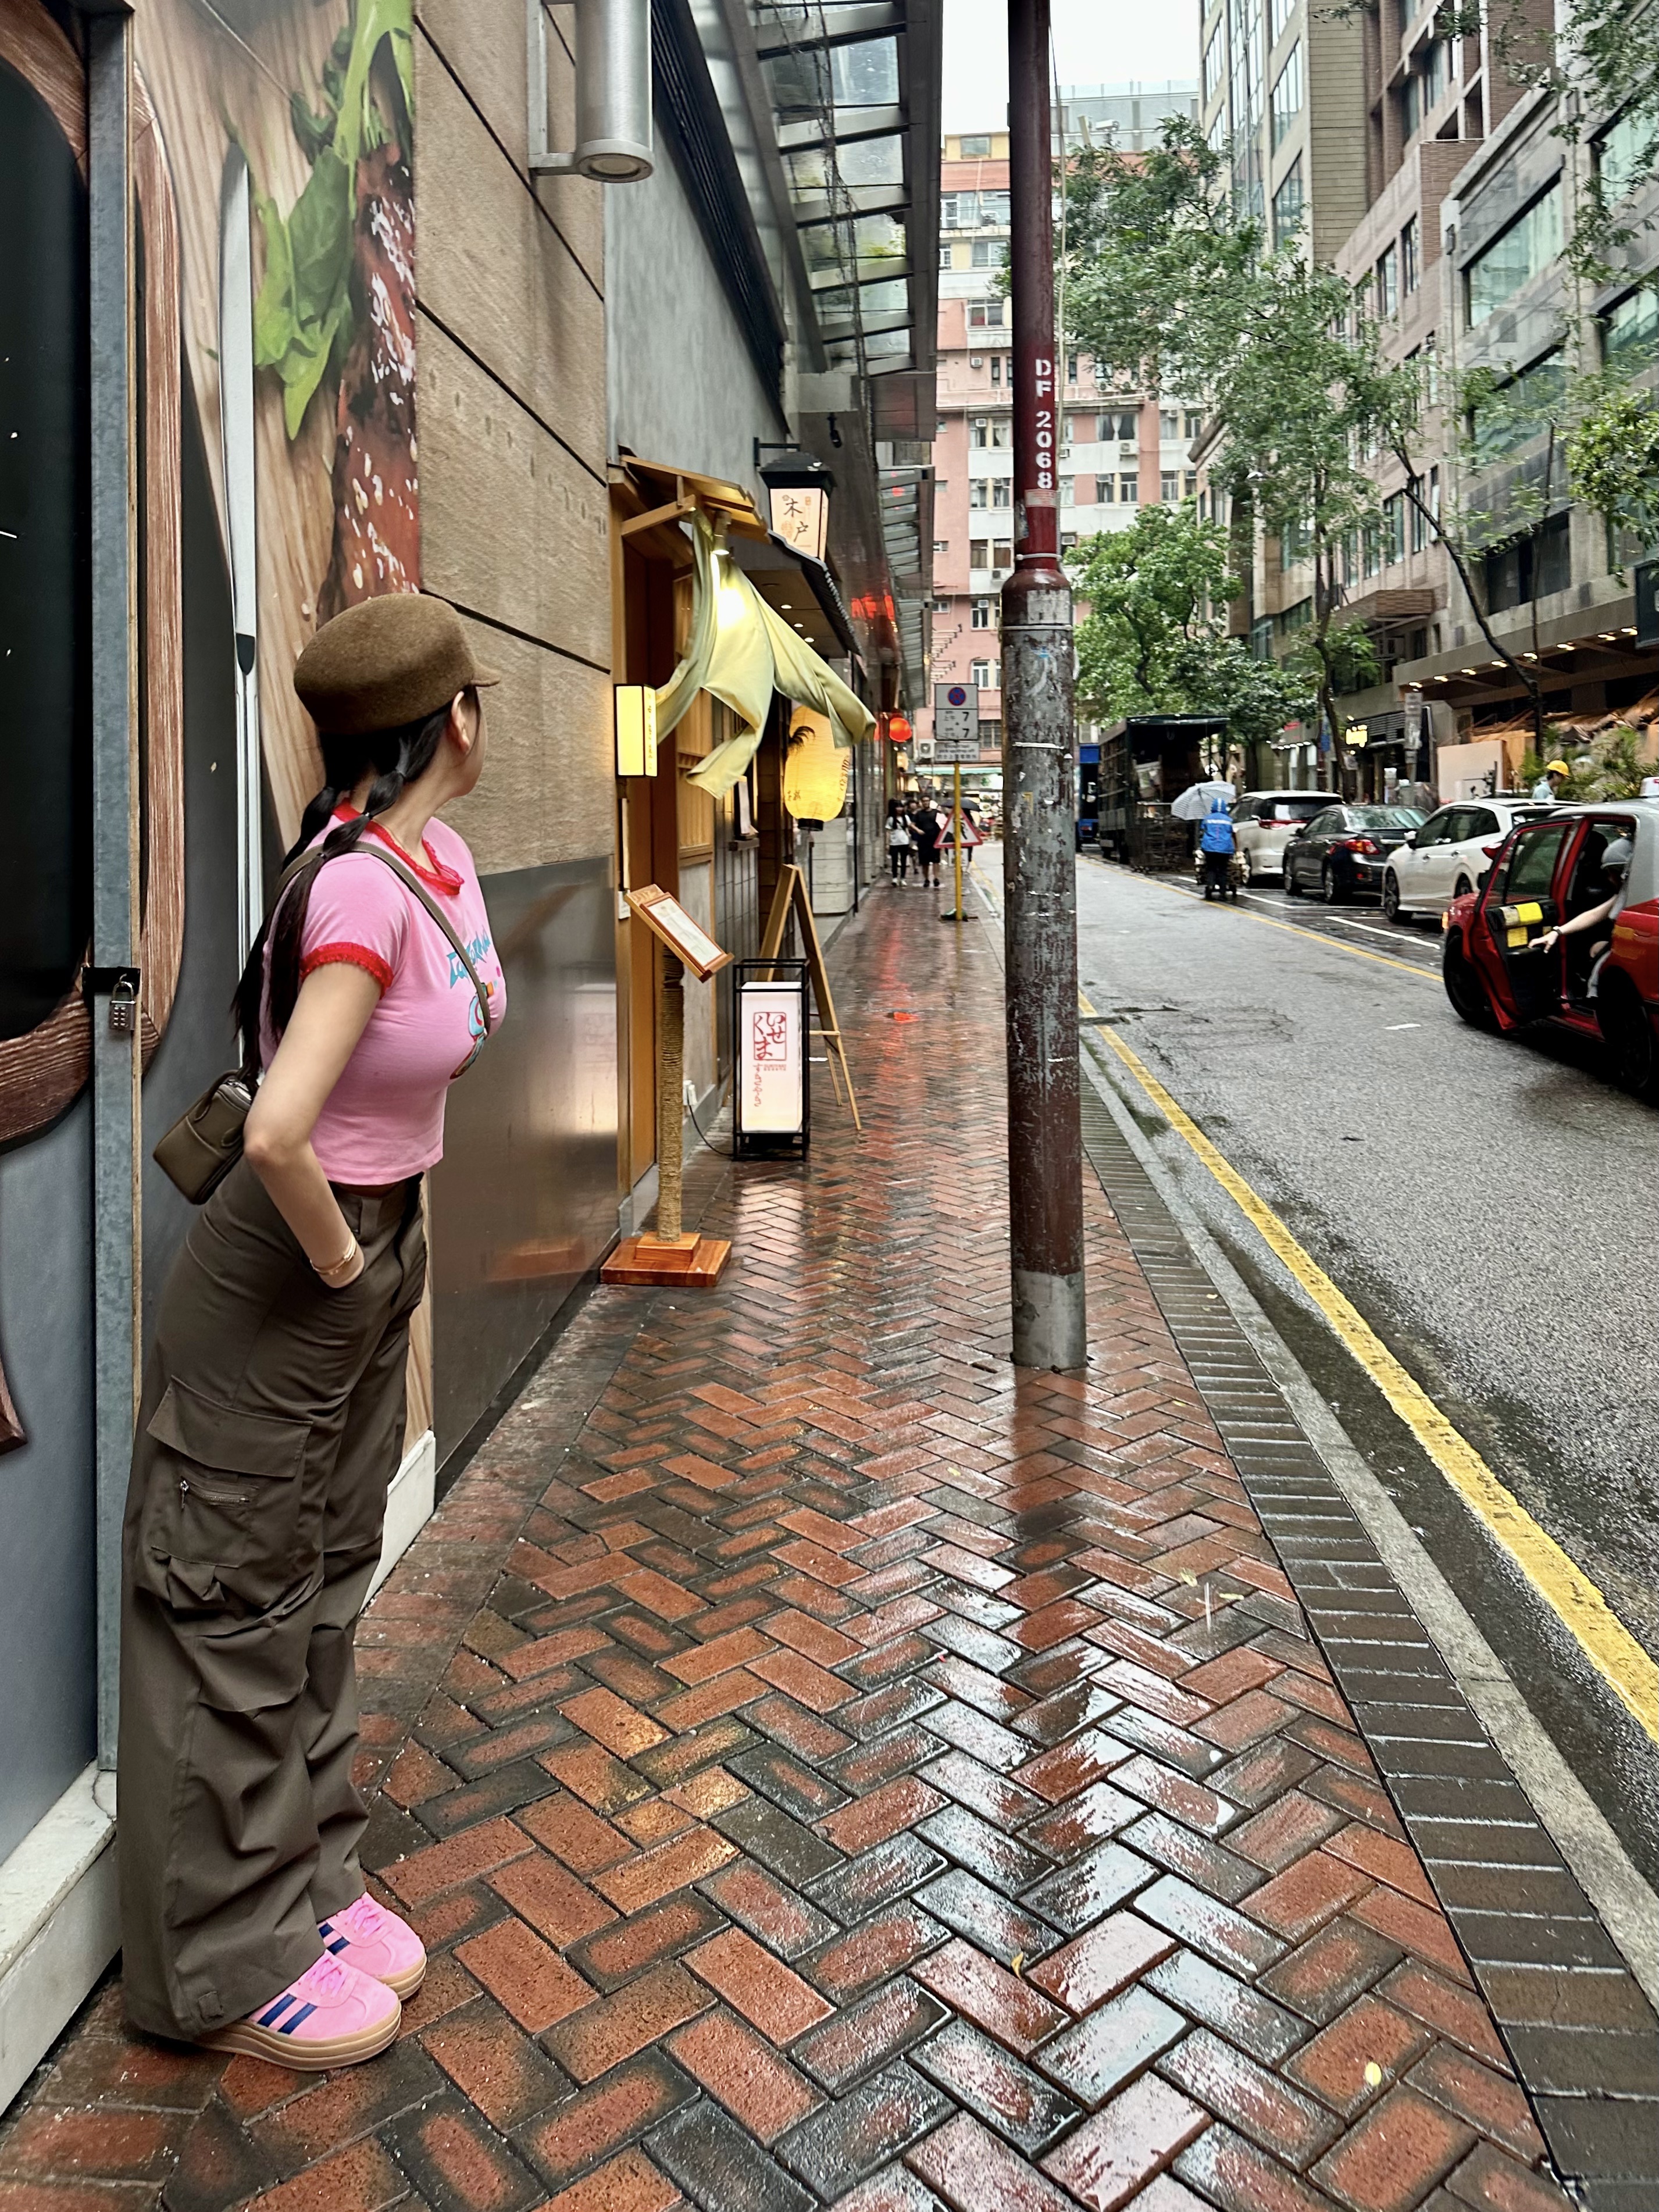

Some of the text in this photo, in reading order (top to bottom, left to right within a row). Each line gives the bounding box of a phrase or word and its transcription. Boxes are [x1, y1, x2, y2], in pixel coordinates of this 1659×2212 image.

[1035, 359, 1053, 489] DF 2068
[962, 711, 969, 721] 7
[962, 728, 969, 738] 7
